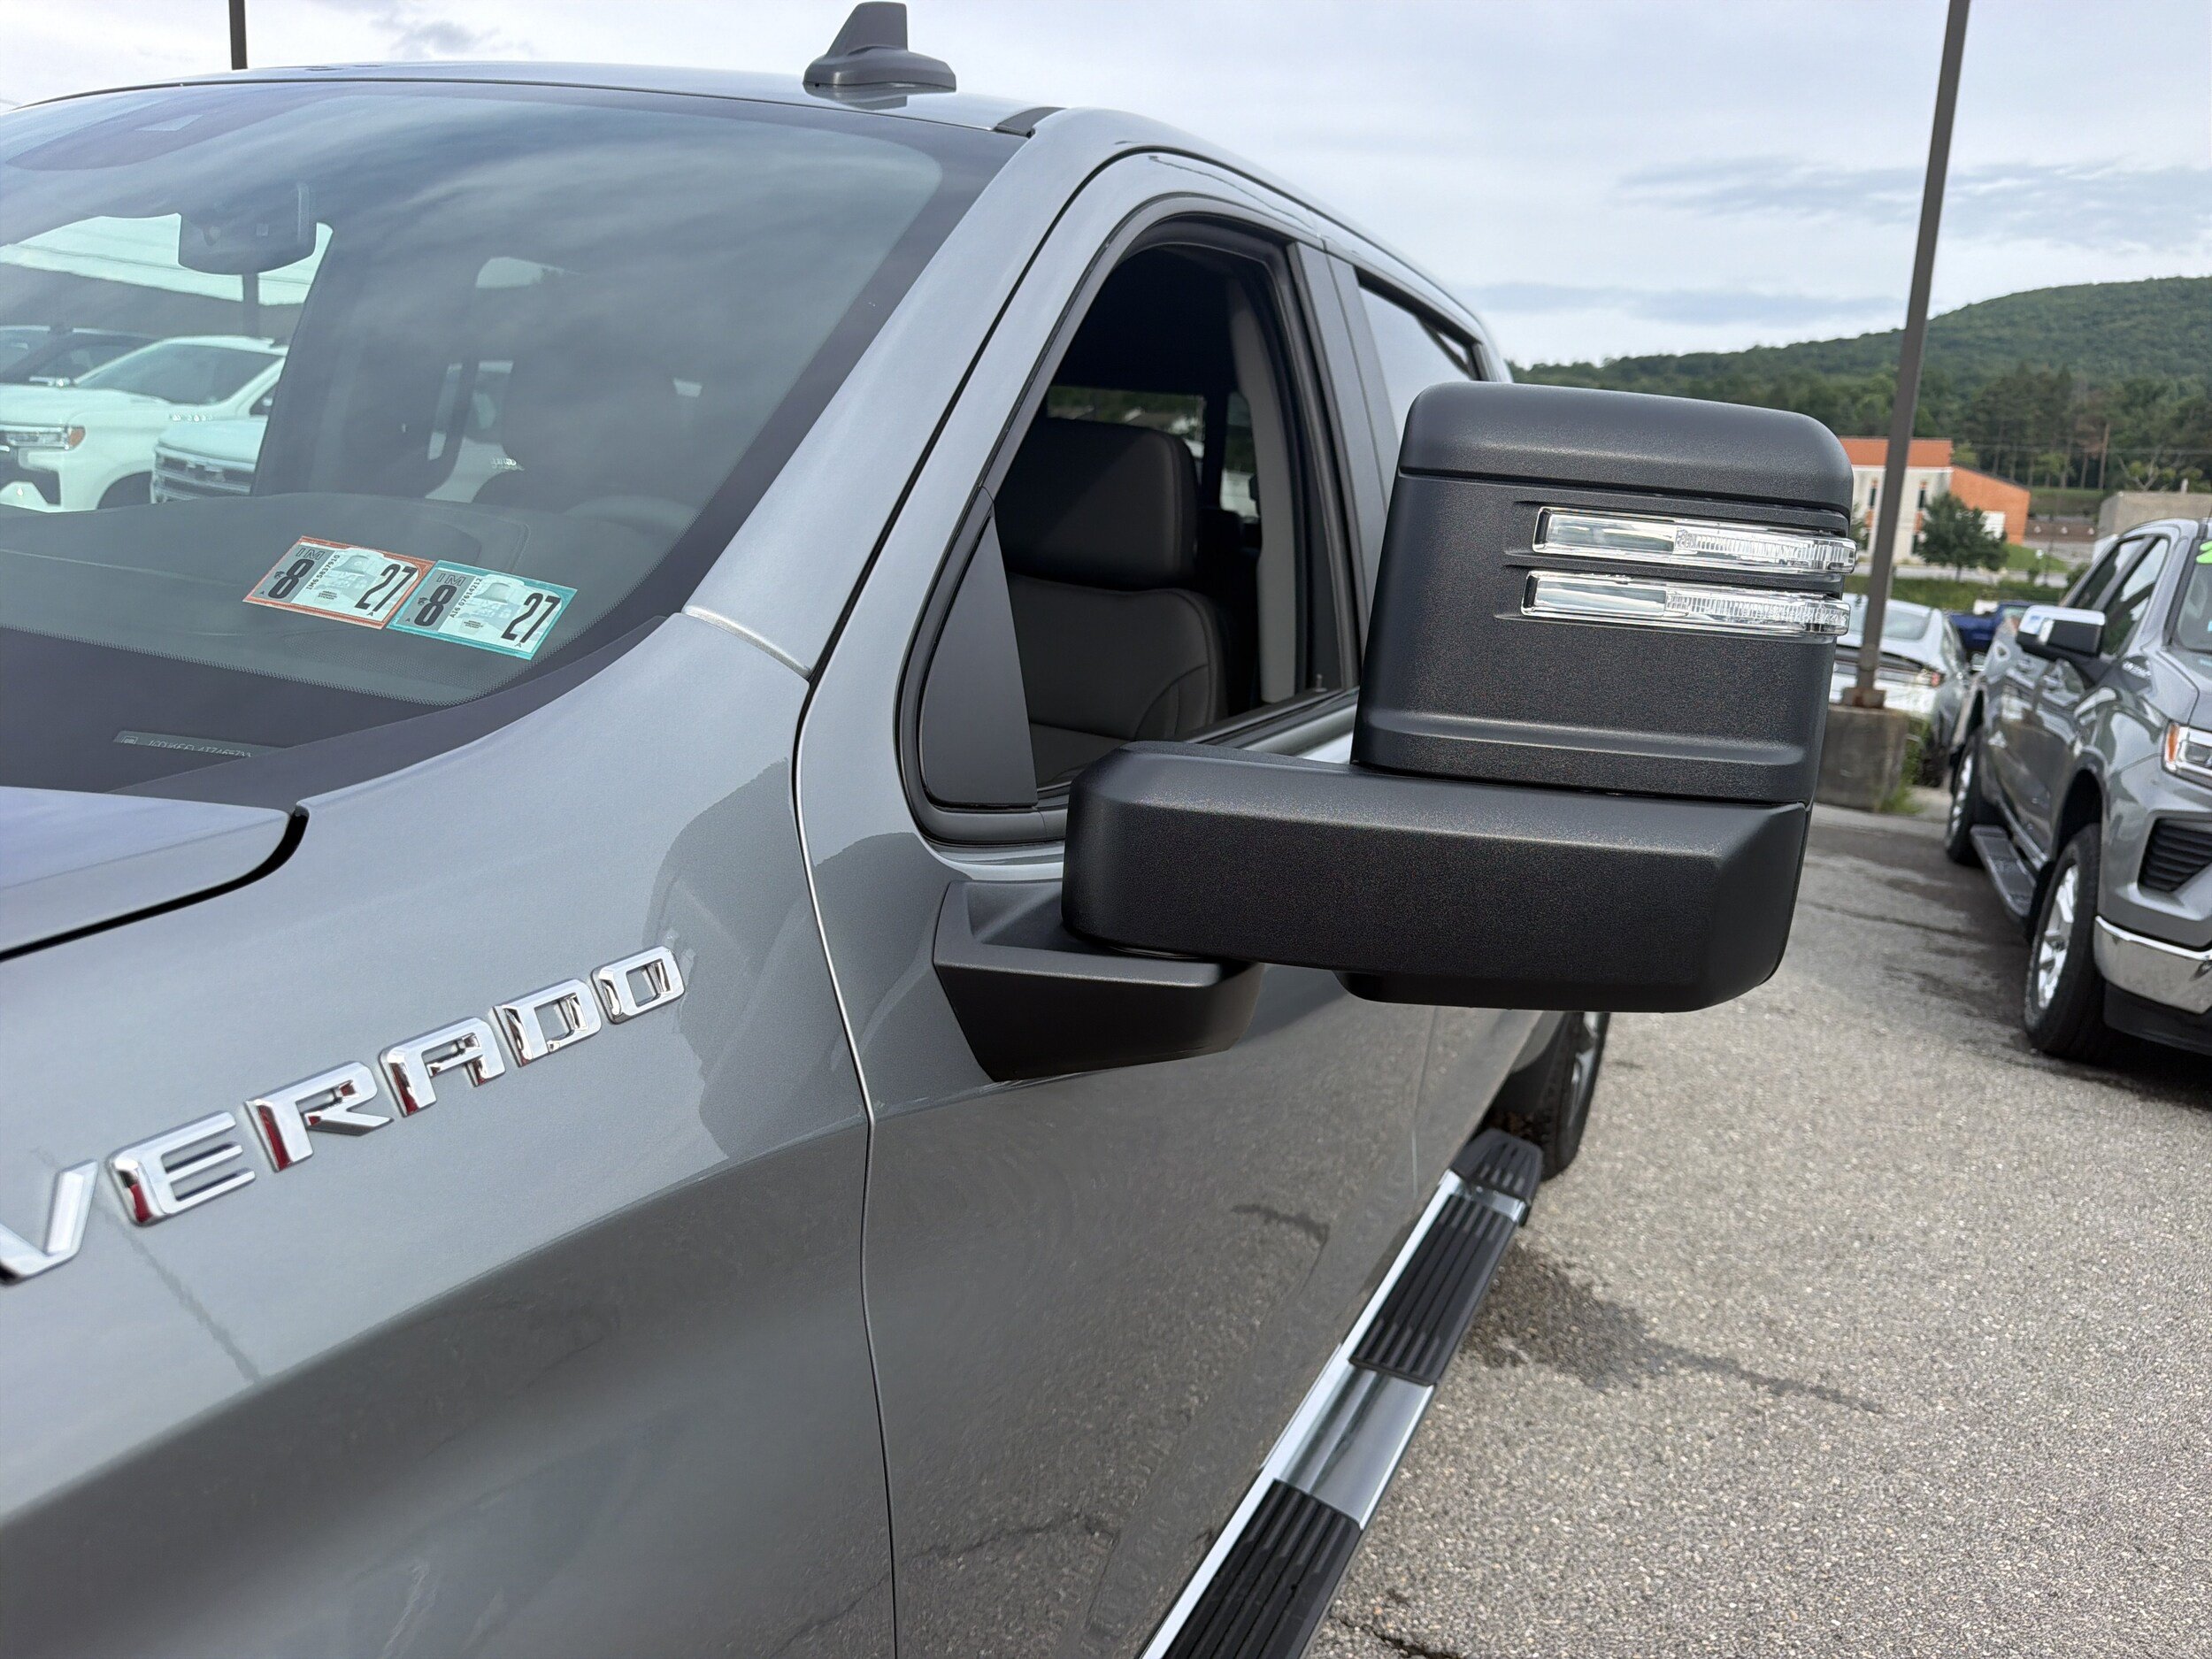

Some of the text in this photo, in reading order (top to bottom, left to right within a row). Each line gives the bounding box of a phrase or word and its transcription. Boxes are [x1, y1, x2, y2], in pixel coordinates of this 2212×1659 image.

[296, 547, 326, 561] IM
[268, 558, 315, 599] 8
[354, 563, 418, 612] 27
[436, 572, 466, 587] IM
[414, 584, 457, 626] 8
[501, 592, 562, 643] 27
